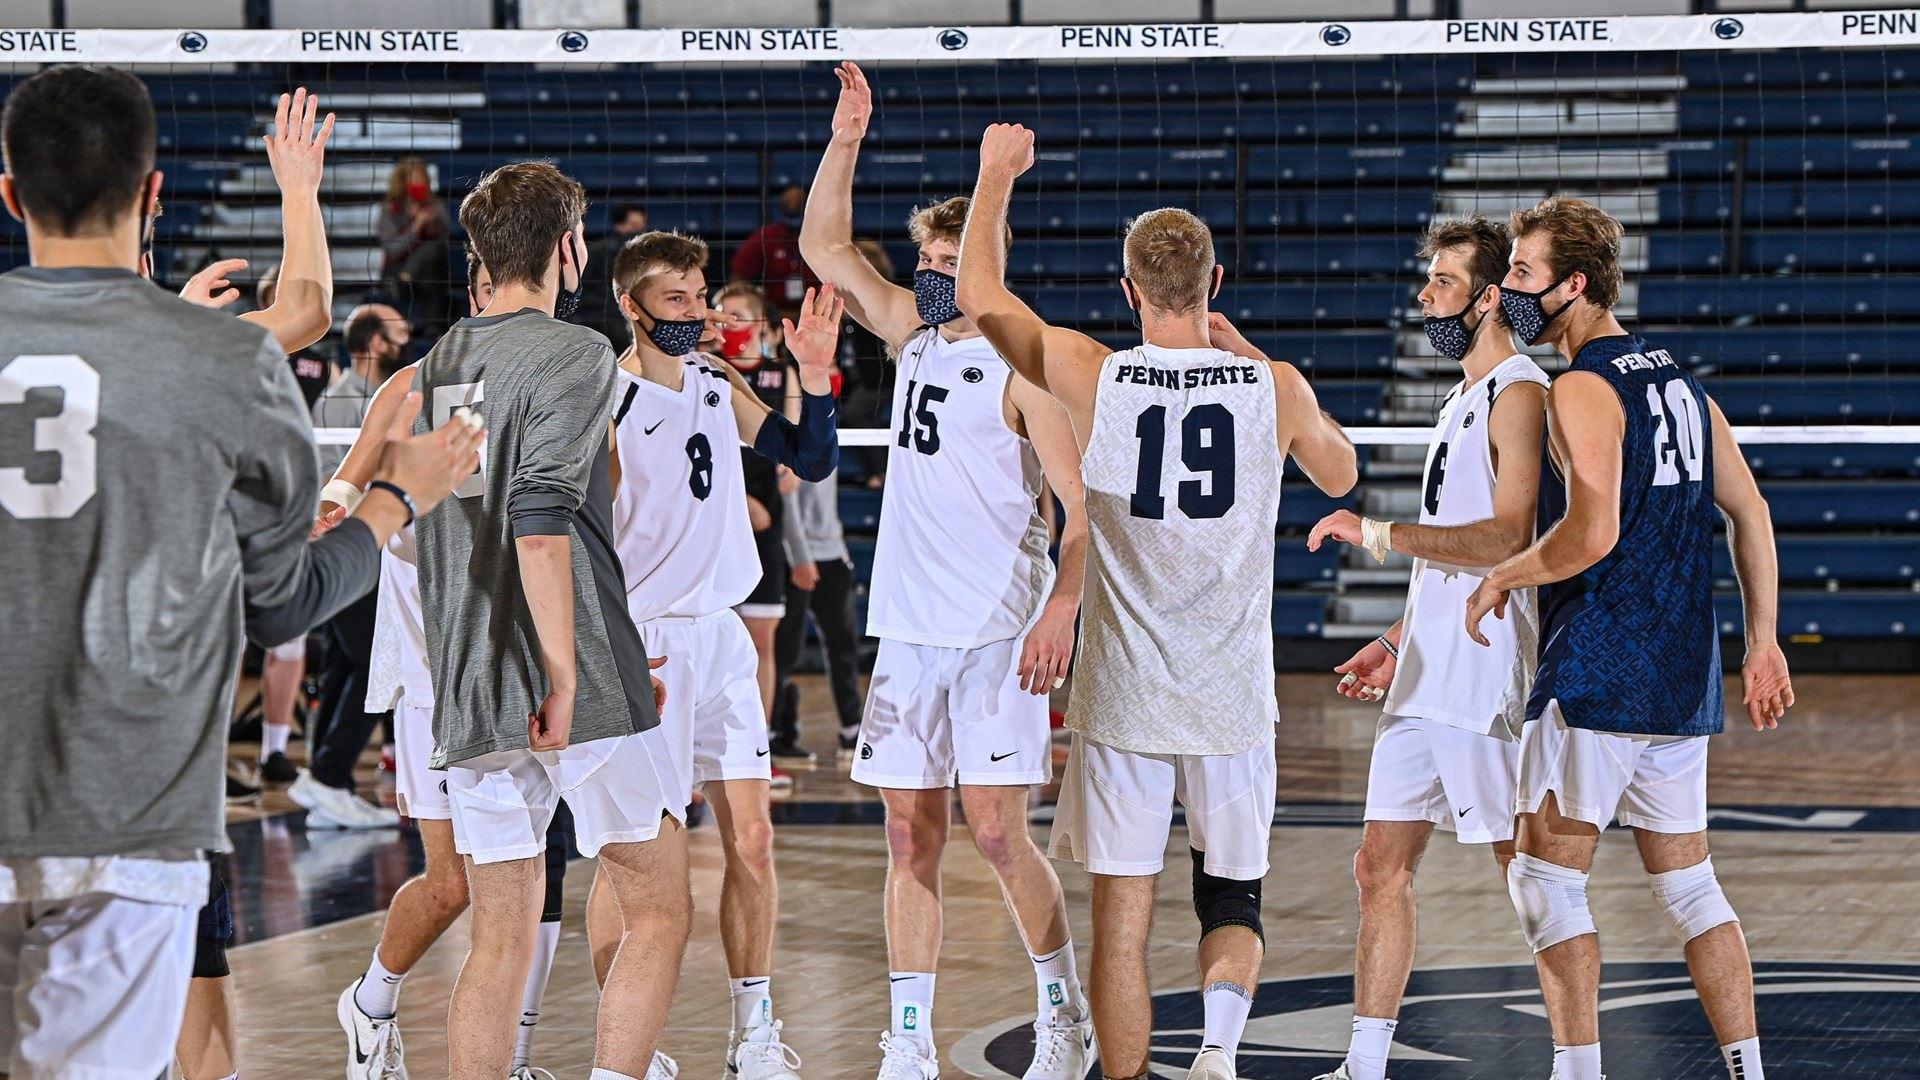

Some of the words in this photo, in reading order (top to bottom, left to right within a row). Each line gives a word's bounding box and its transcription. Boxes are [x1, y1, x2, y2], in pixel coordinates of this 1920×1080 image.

[1061, 26, 1132, 48] PENN
[1141, 26, 1220, 48] STATE
[1446, 21, 1519, 43] PENN
[1527, 19, 1609, 42] STATE
[1842, 13, 1917, 36] PENN
[0, 31, 77, 51] STATE
[301, 30, 371, 51] PENN
[381, 30, 459, 51] STATE
[681, 30, 751, 51] PENN
[761, 29, 839, 50] STATE
[1115, 364, 1181, 391] PENN
[1184, 364, 1258, 389] STATE
[897, 379, 951, 456] 15
[0, 354, 100, 520] 3
[1646, 378, 1704, 487] 20
[684, 431, 714, 503] 8
[1129, 402, 1237, 521] 19
